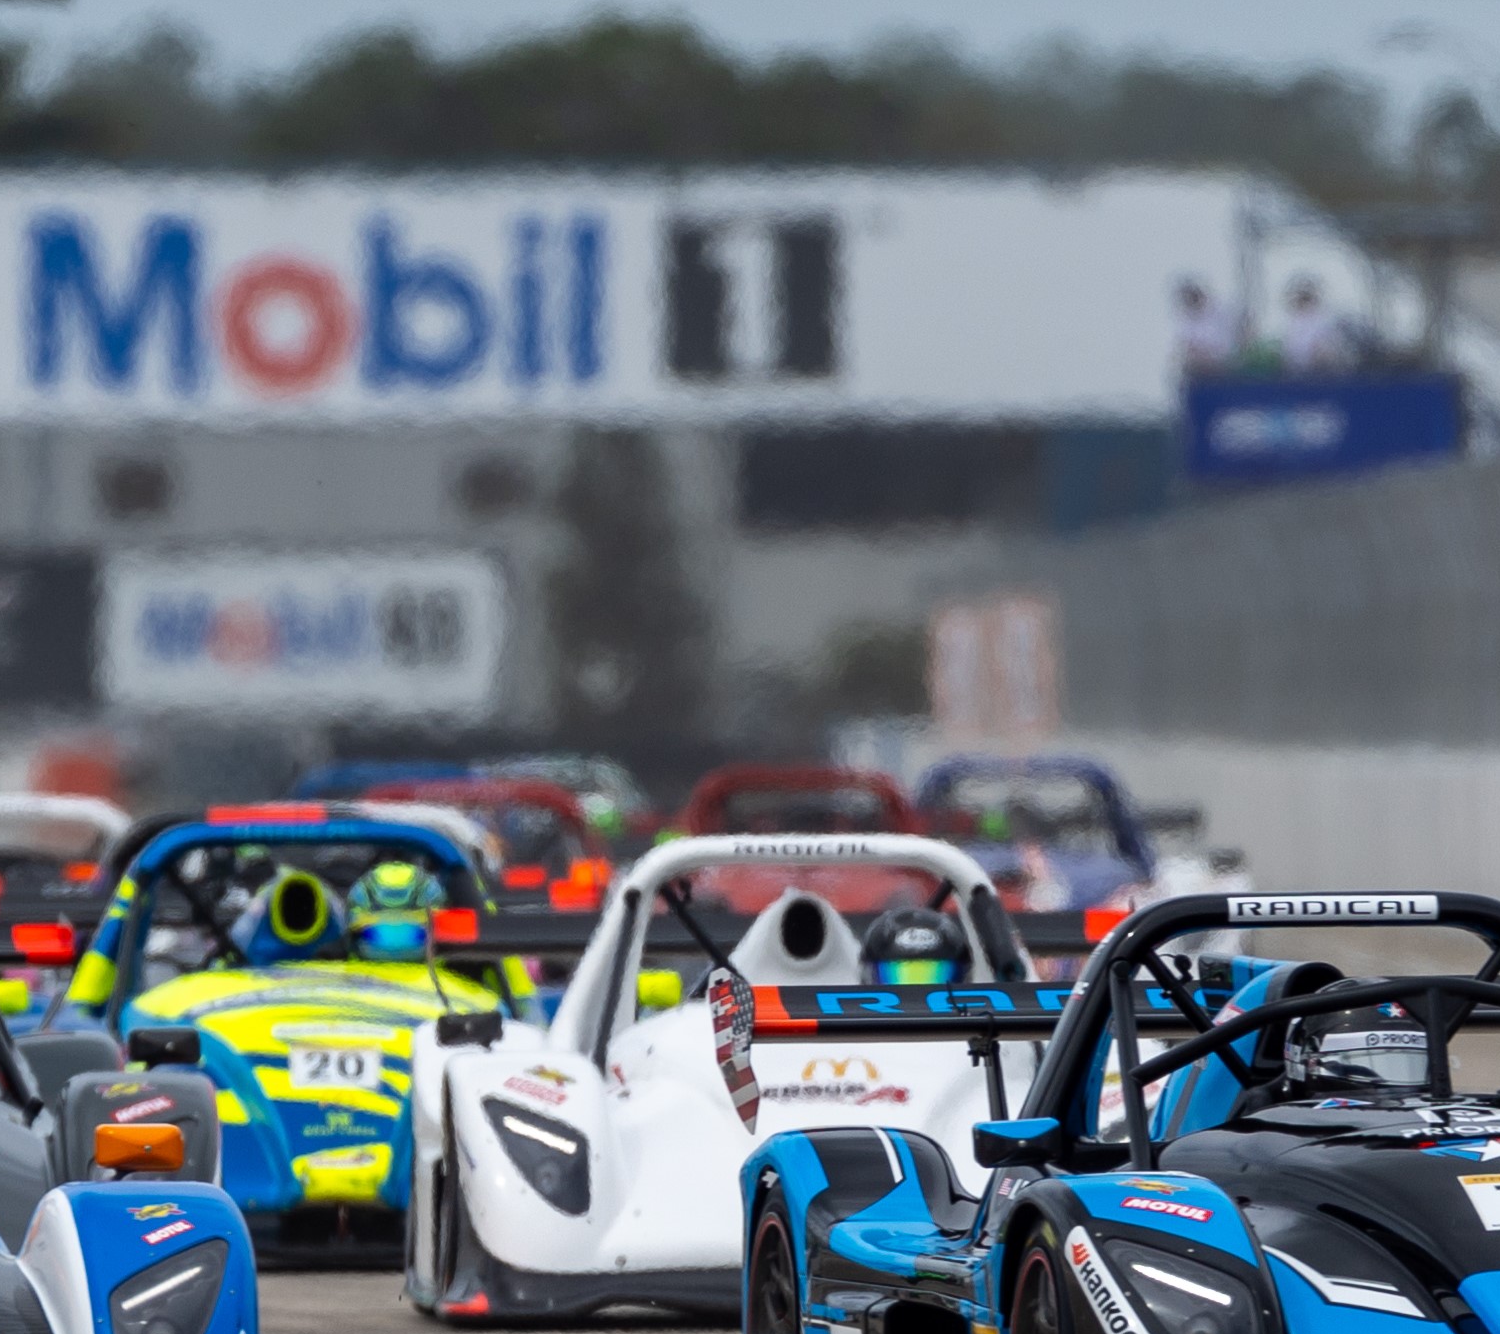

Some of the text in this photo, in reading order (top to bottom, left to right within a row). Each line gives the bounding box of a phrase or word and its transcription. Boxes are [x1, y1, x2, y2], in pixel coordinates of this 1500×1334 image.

[22, 207, 606, 393] Mobil
[1236, 899, 1432, 917] RADICAL
[304, 1051, 365, 1080] 20
[1124, 1198, 1208, 1221] MOTUL
[144, 1221, 190, 1244] MOTUL
